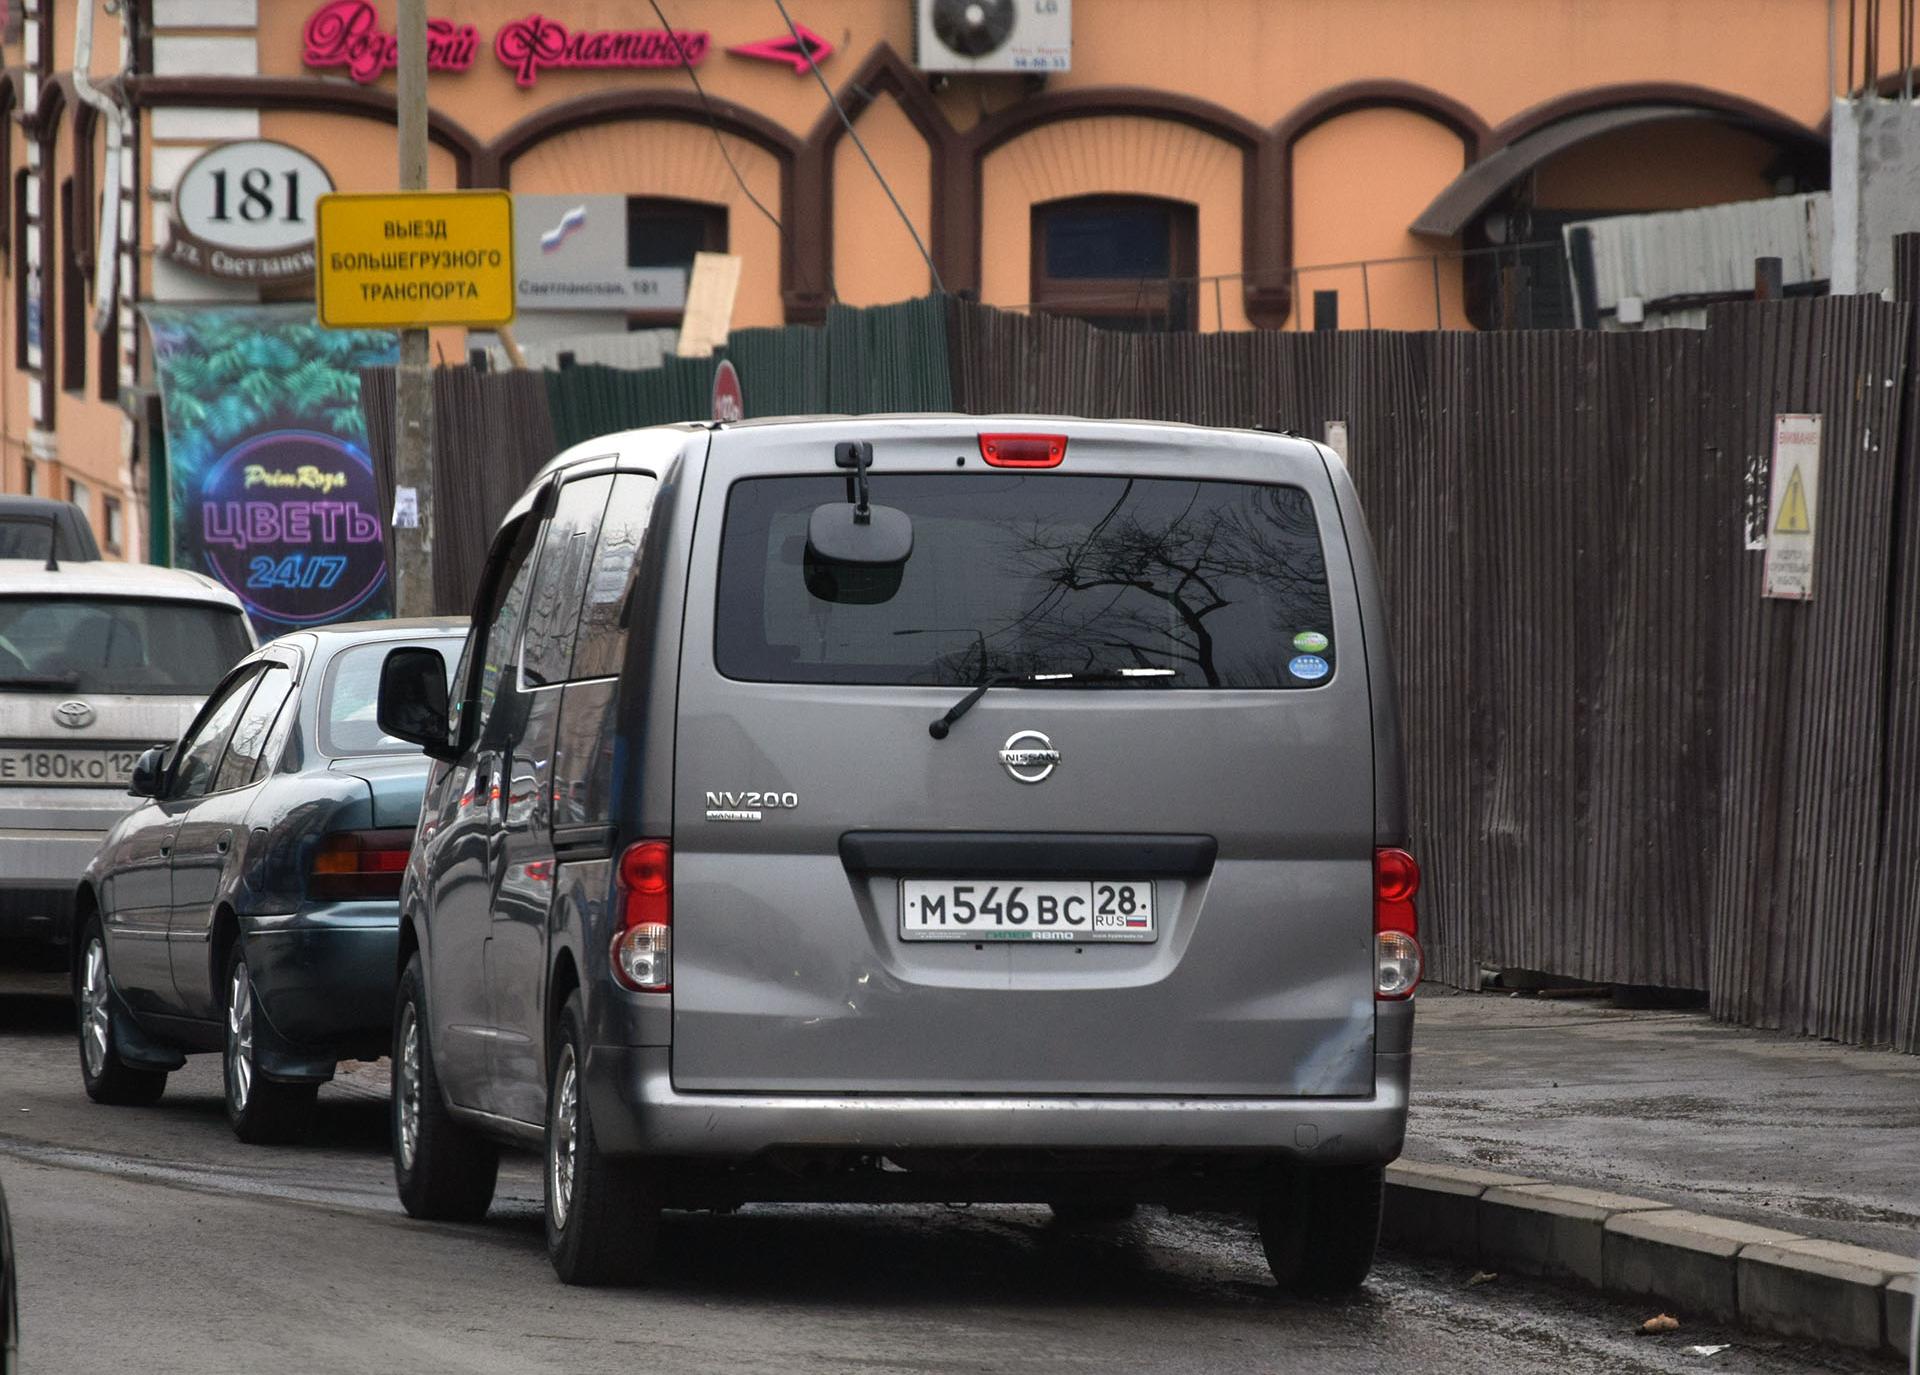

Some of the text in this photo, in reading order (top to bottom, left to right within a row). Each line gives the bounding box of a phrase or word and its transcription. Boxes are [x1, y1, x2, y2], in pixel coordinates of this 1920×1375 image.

[305, 1, 707, 84] Розоый Фламинго
[206, 167, 304, 223] 181
[383, 219, 448, 240] ВЫЕЗД
[210, 249, 316, 277] Светланск
[330, 249, 501, 273] БОЛЬШЕГРУЗНОГО
[359, 280, 478, 301] ТРАНСПОРТА
[633, 279, 659, 295] 181
[247, 556, 347, 588] 24/7
[1, 754, 104, 778] Е180КО
[109, 754, 141, 773] 12
[1005, 753, 1056, 761] NISSAN
[706, 791, 798, 808] NV200
[920, 886, 1085, 925] М546ВС
[1097, 886, 1136, 914] 28
[1095, 915, 1124, 926] RUS
